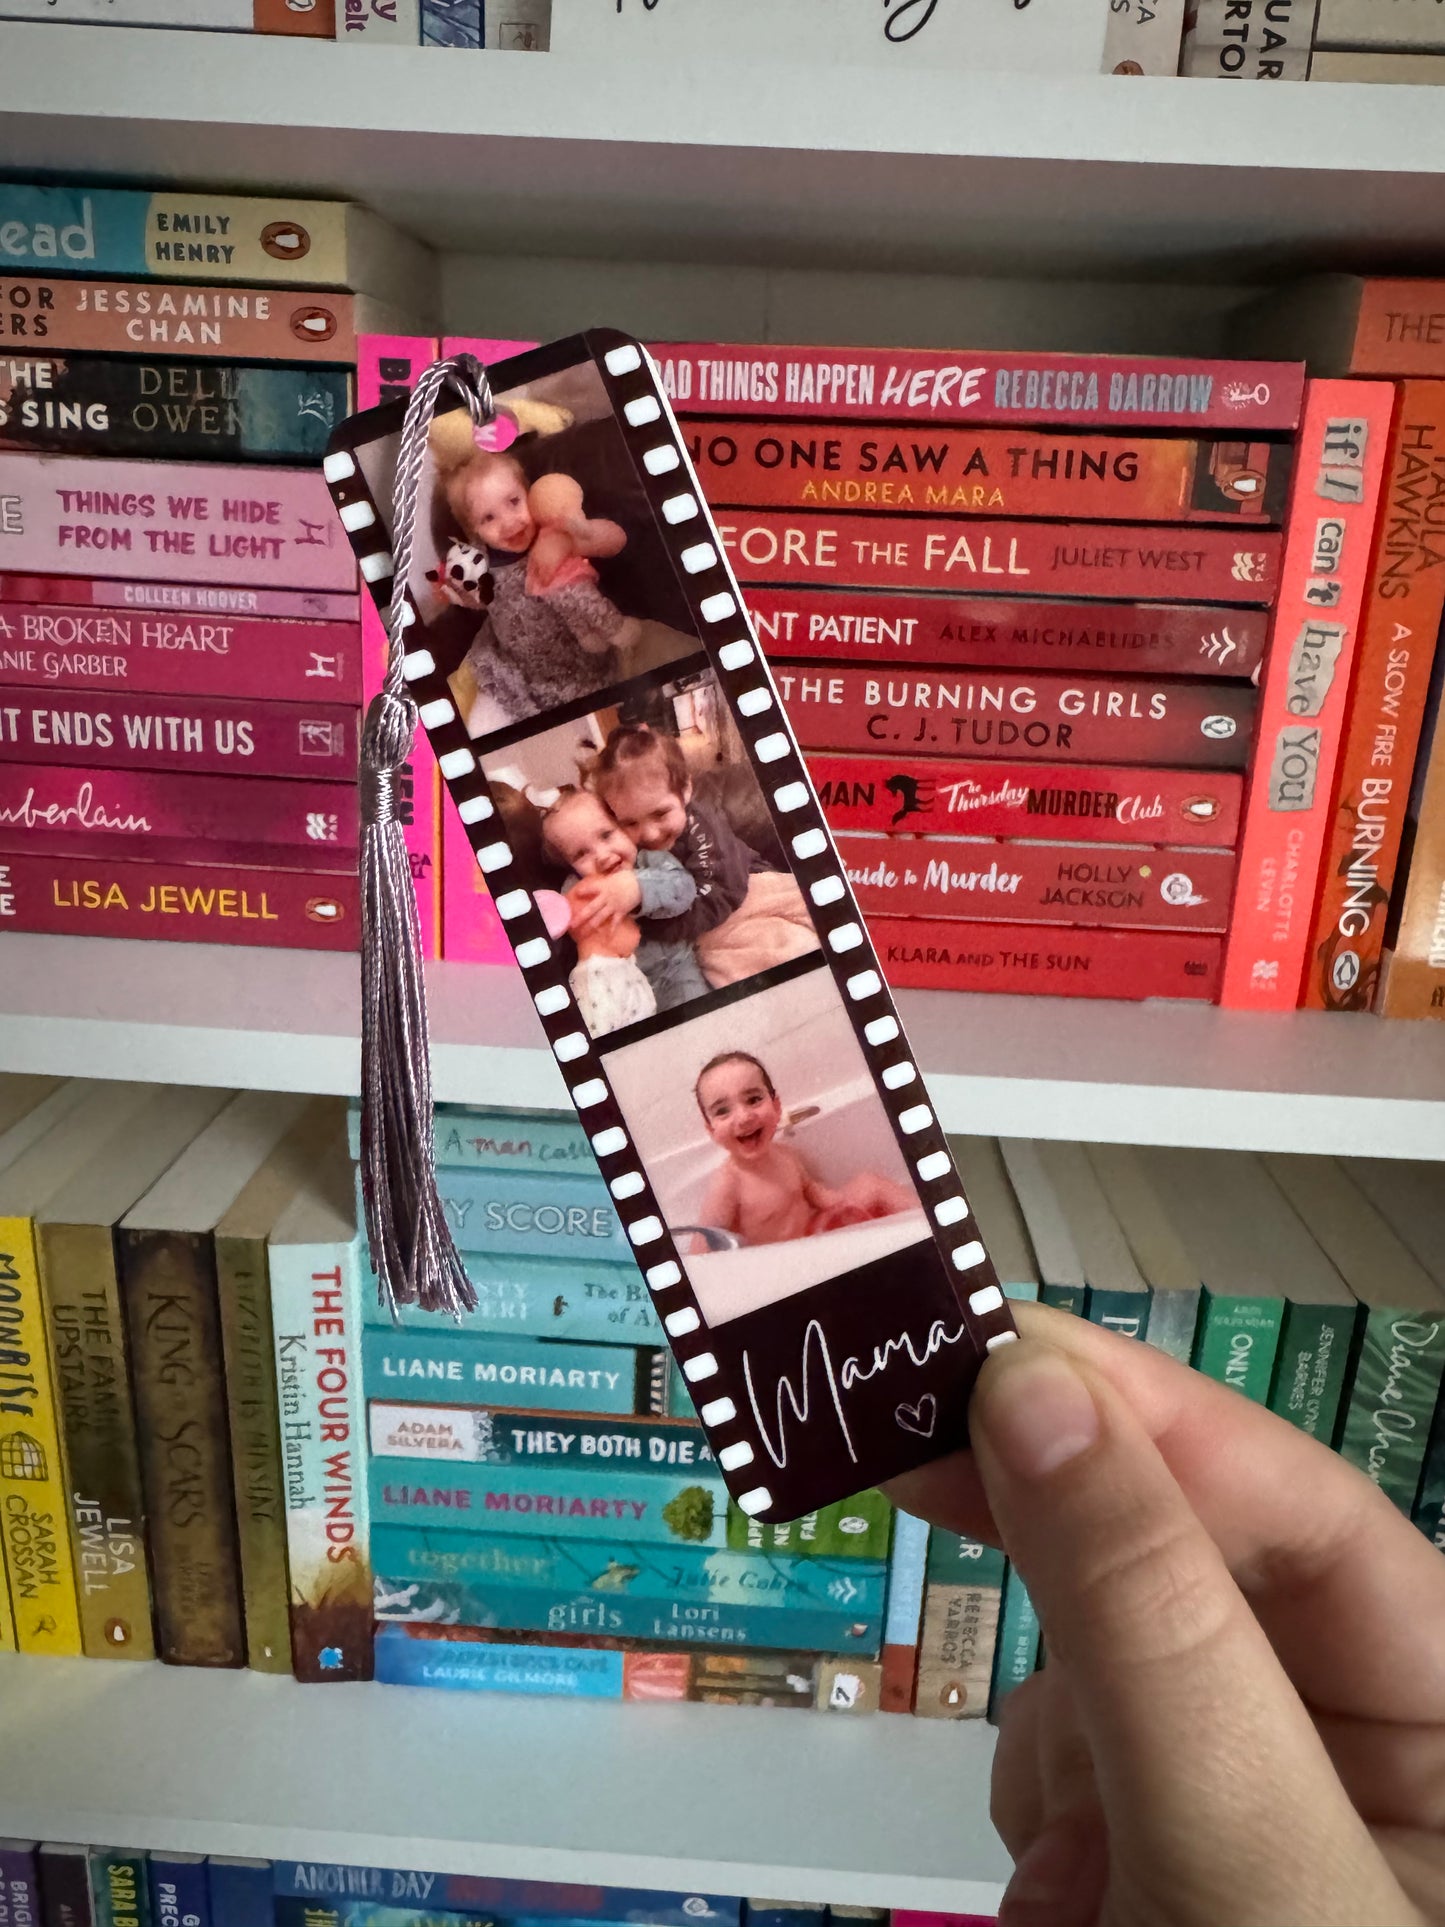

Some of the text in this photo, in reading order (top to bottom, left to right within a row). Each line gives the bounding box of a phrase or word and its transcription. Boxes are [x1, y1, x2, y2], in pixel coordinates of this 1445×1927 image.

[0, 196, 96, 260] ead
[156, 213, 230, 235] EMILY
[155, 241, 235, 264] HENRY
[76, 289, 271, 320] JESSAMINE
[126, 318, 222, 345] CHAN
[698, 360, 779, 403] THINGS
[785, 363, 874, 405] HAPPEN
[880, 366, 986, 408] HERE
[995, 368, 1098, 411] REBECCA
[1108, 372, 1214, 414] BARROW
[21, 401, 109, 431] SING
[755, 438, 842, 471] ONE
[859, 442, 950, 475] SAW
[962, 447, 989, 476] A
[1007, 448, 1139, 482] THING
[56, 489, 282, 525] THINGS WE HIDE
[801, 480, 1005, 507] ANDREA MARA
[1378, 424, 1436, 600] HAWKINS
[58, 525, 285, 559] FROM THE LIGHT
[718, 526, 1209, 575] FORE THE FALL JULIET WEST
[124, 585, 258, 610] COLLEEN HOOVER
[21, 614, 131, 646] BROKEN
[141, 621, 234, 655] HEART
[809, 612, 918, 646] PATIENT
[939, 624, 996, 642] ALEX
[43, 651, 128, 679] GARBER
[1288, 627, 1340, 714] have
[780, 676, 1168, 720] THE BURNING GIRLS
[33, 709, 114, 748] ENDS
[123, 714, 203, 753] WITH
[214, 719, 255, 756] US
[951, 717, 1073, 749] TUDOR
[1278, 730, 1318, 803] You
[1338, 622, 1412, 938] A SLOW FIRE BURNING
[1027, 788, 1119, 819] MURDER
[1116, 794, 1164, 825] Club
[841, 858, 898, 888] uide
[924, 859, 1023, 894] Murder
[1057, 862, 1132, 884] HOLLY
[1272, 829, 1304, 941] CHARLOTTE
[53, 879, 129, 911] LISA
[140, 885, 279, 920] JEWELL
[1039, 888, 1144, 909] JACKSON
[887, 946, 1091, 971] KLARA AND THE SUN
[485, 1201, 614, 1239] SCORE
[82, 1286, 113, 1345] THE
[146, 1291, 194, 1387] KING
[382, 1357, 622, 1391] LIANE MORIARTY
[1225, 1333, 1254, 1388] ONLY
[742, 1319, 966, 1469] Mama
[278, 1333, 315, 1510] Kristin Hannah
[311, 1265, 355, 1564] THE FOUR WINDS
[397, 1421, 454, 1436] ADAM
[511, 1429, 576, 1455] THEY
[580, 1433, 642, 1459] BOTH
[648, 1436, 695, 1464] DIE
[158, 1419, 206, 1529] SCARS
[382, 1485, 648, 1521] LIANE MORIARTY
[5, 1494, 39, 1599] CROSSAN
[31, 1512, 60, 1585] SARAH
[73, 1491, 111, 1597] JEWELL
[106, 1517, 136, 1576] LISA
[547, 1600, 624, 1631] girls
[653, 1619, 748, 1641] Lansens
[671, 1602, 721, 1621] Lori
[107, 1864, 138, 1911] SARA
[392, 1872, 436, 1900] DAY
